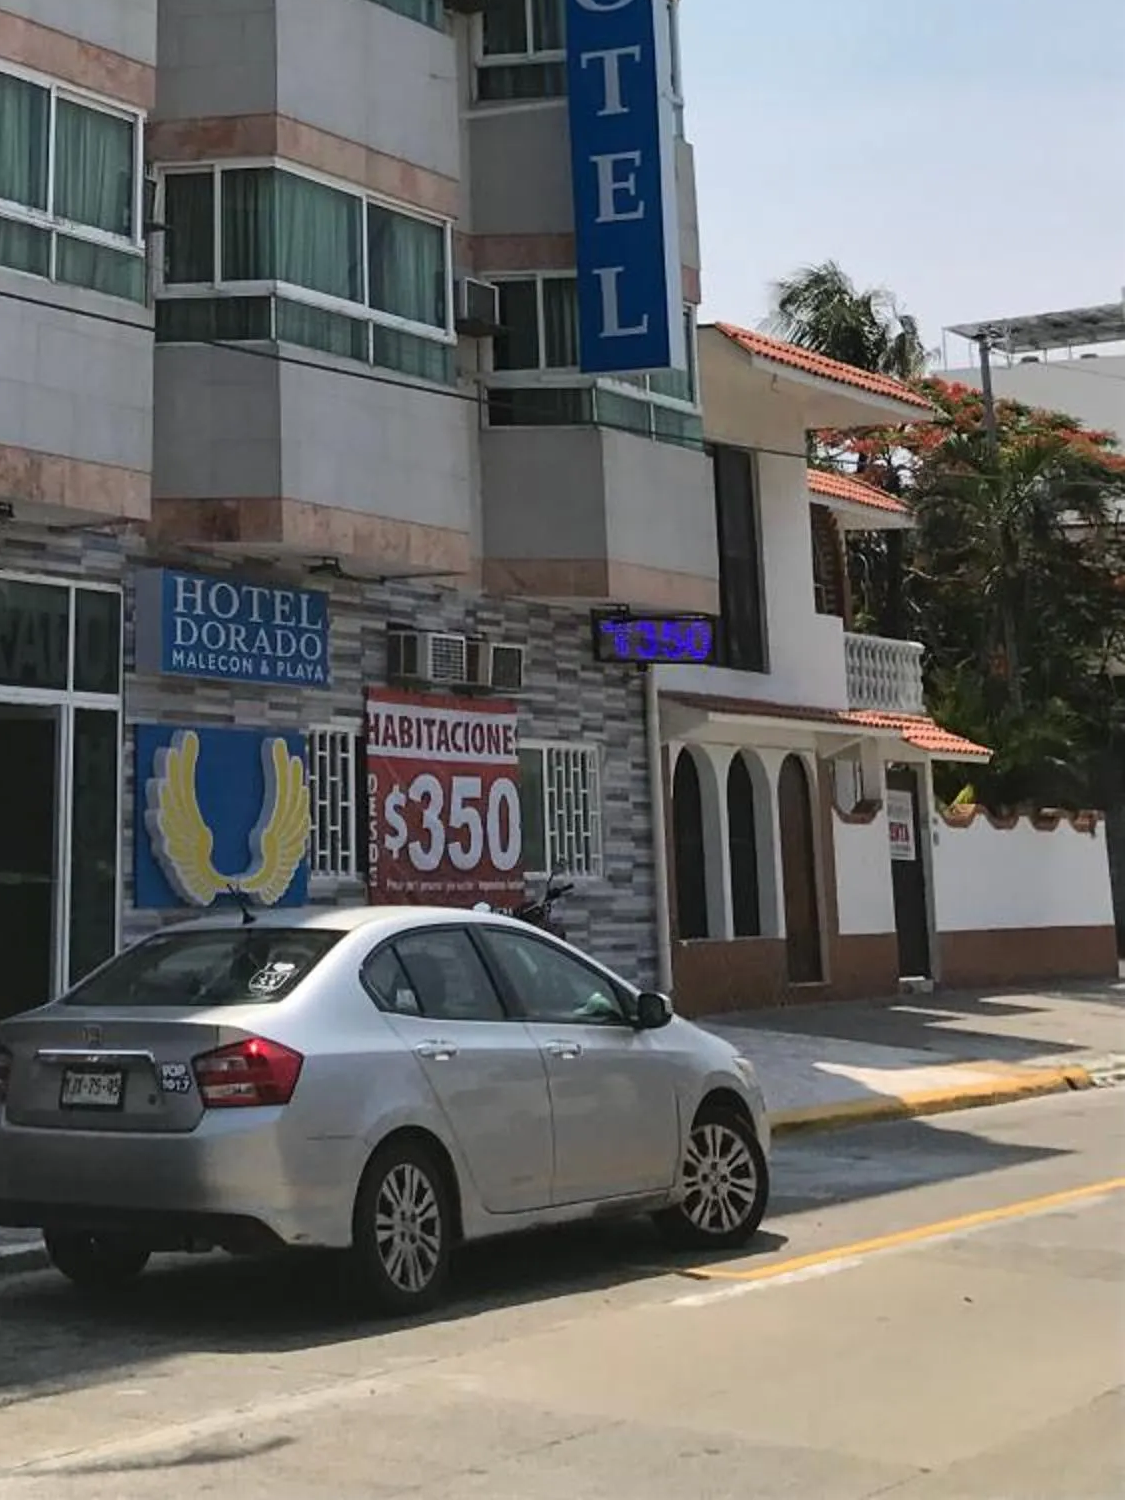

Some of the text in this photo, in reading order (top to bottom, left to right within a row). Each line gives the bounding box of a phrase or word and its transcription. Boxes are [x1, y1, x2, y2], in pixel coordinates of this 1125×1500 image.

[173, 576, 322, 629] HOTEL
[173, 617, 322, 661] DORADO
[172, 650, 324, 681] MALECON & PLAYA
[366, 712, 519, 755] HABITACIONE
[384, 772, 522, 871] $350
